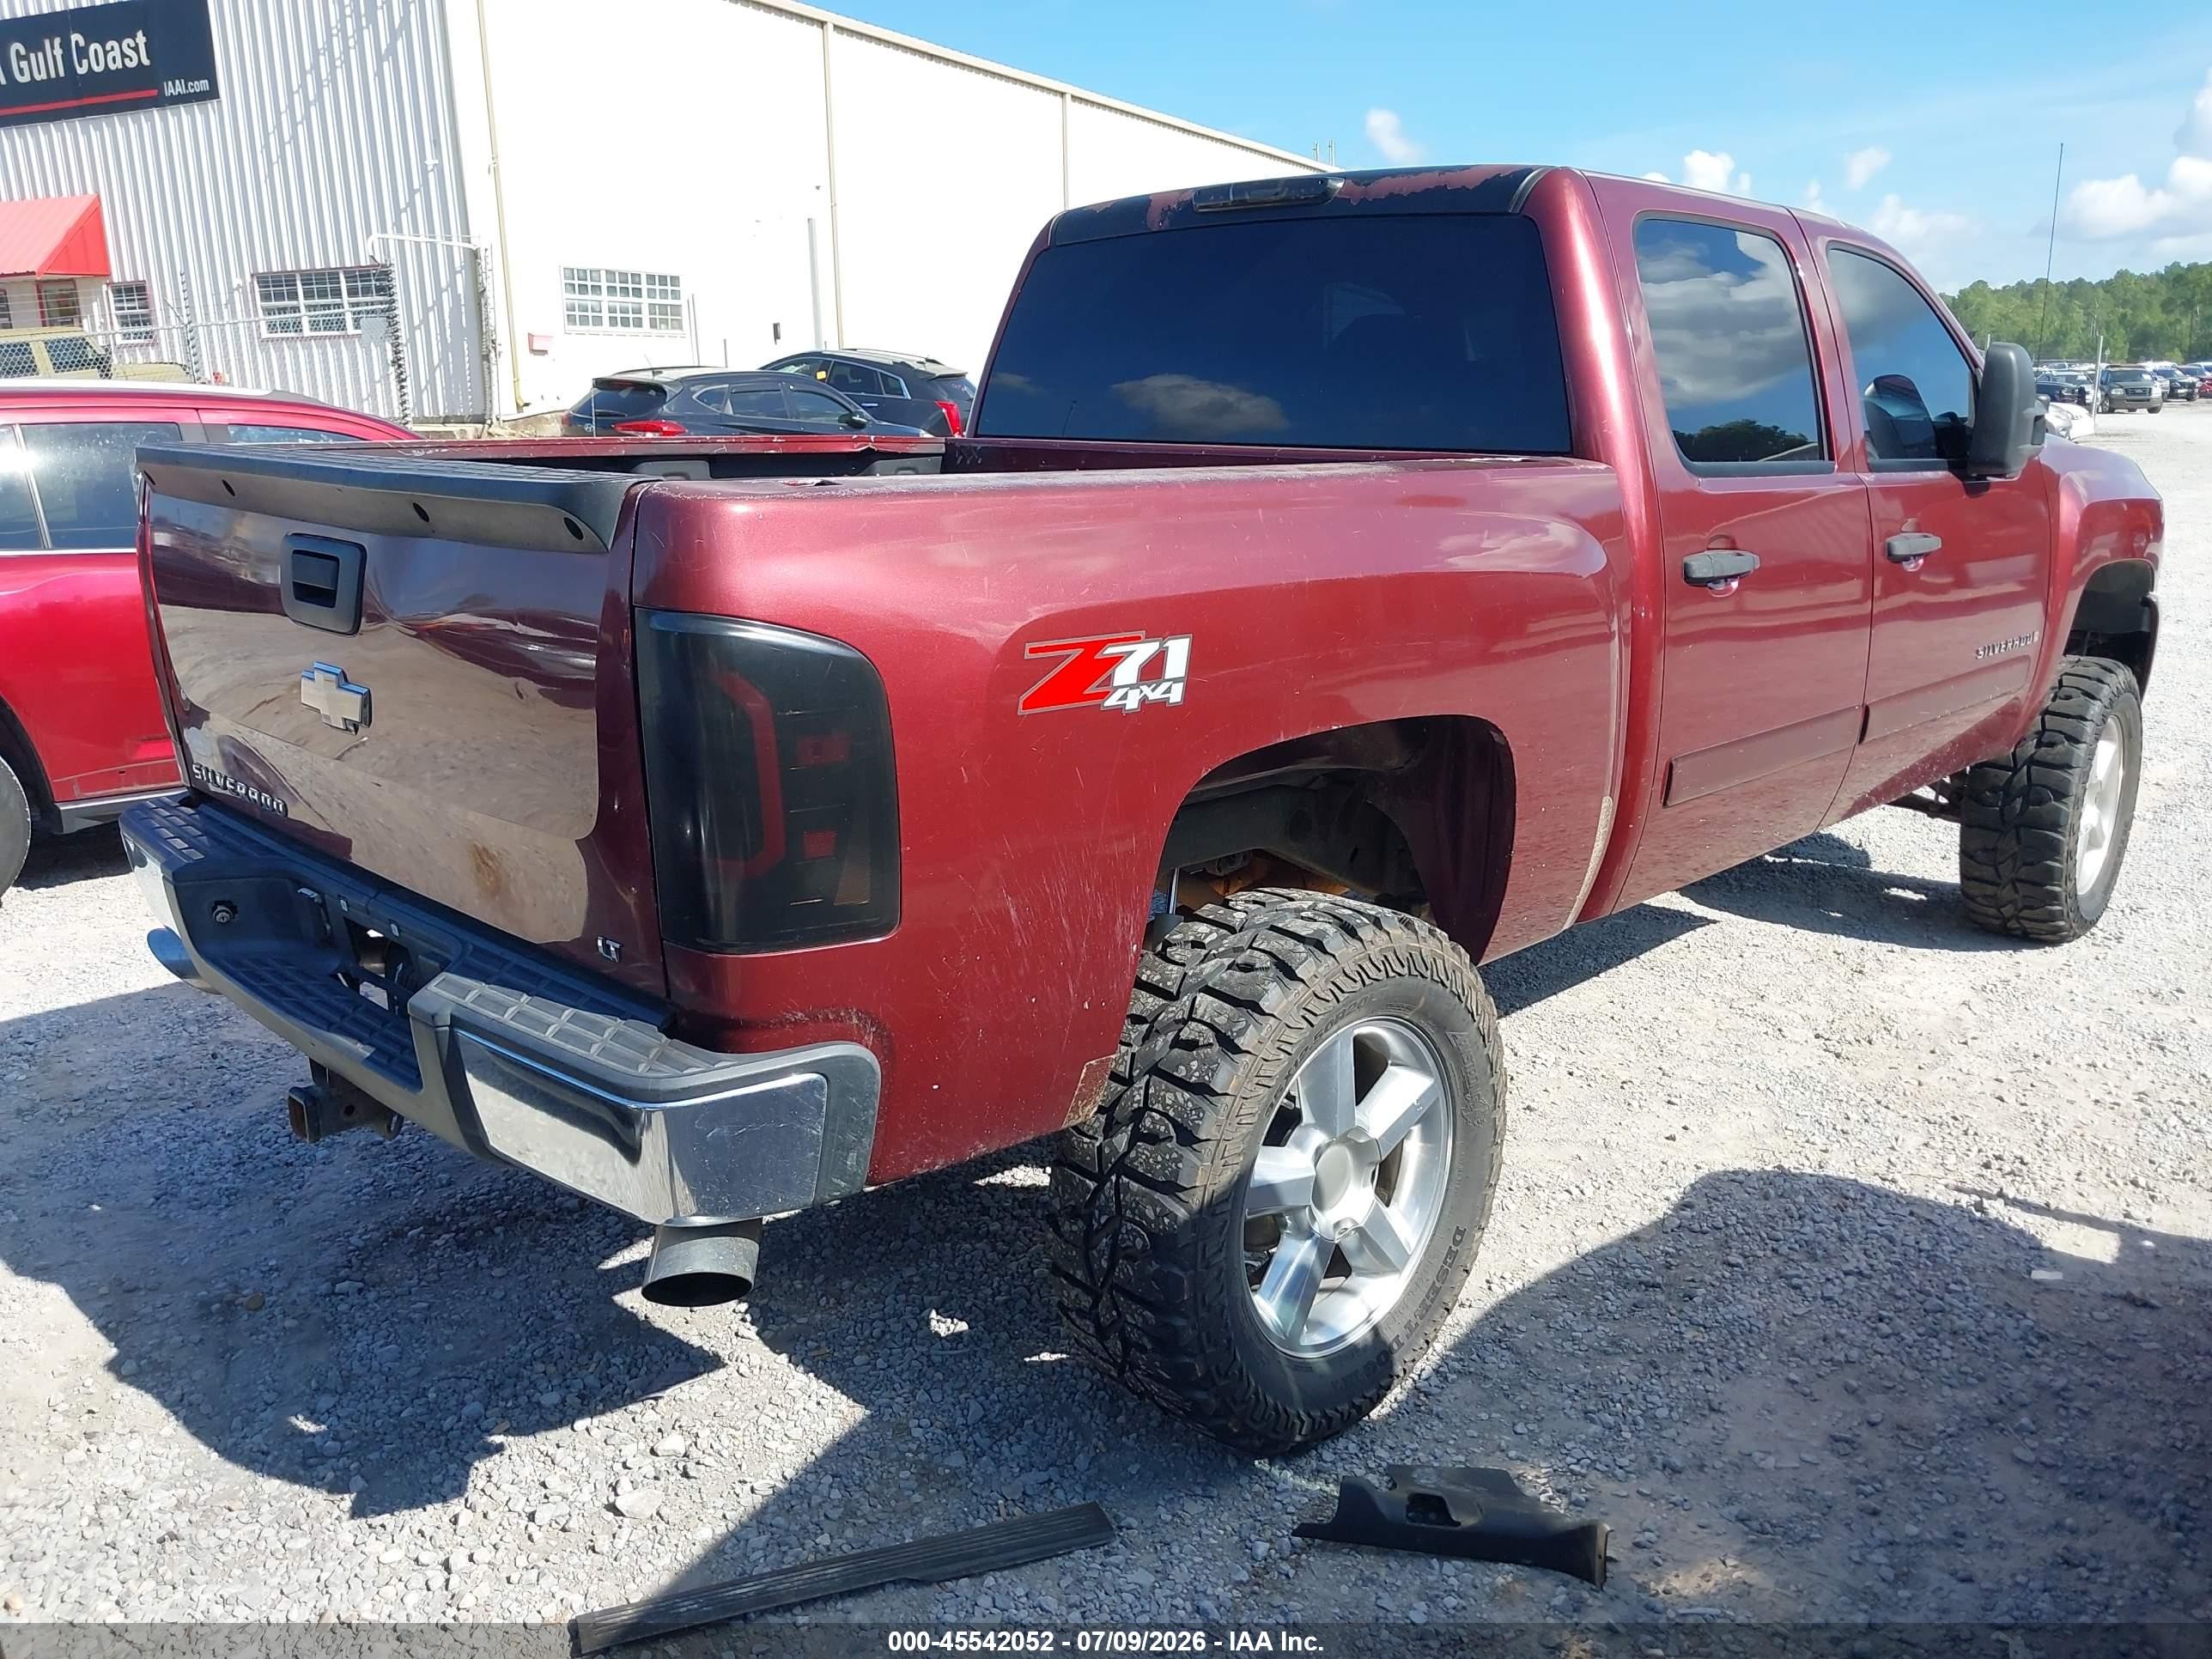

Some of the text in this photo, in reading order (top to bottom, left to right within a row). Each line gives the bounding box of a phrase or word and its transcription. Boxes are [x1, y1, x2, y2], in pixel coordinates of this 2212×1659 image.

[9, 37, 65, 83] Gulf
[70, 29, 151, 76] Coast
[163, 78, 210, 97] IAAI.com
[1018, 631, 1192, 714] Z71
[191, 763, 289, 817] SILVERADO
[597, 935, 622, 963] LT
[1403, 1224, 1468, 1340] DESERT
